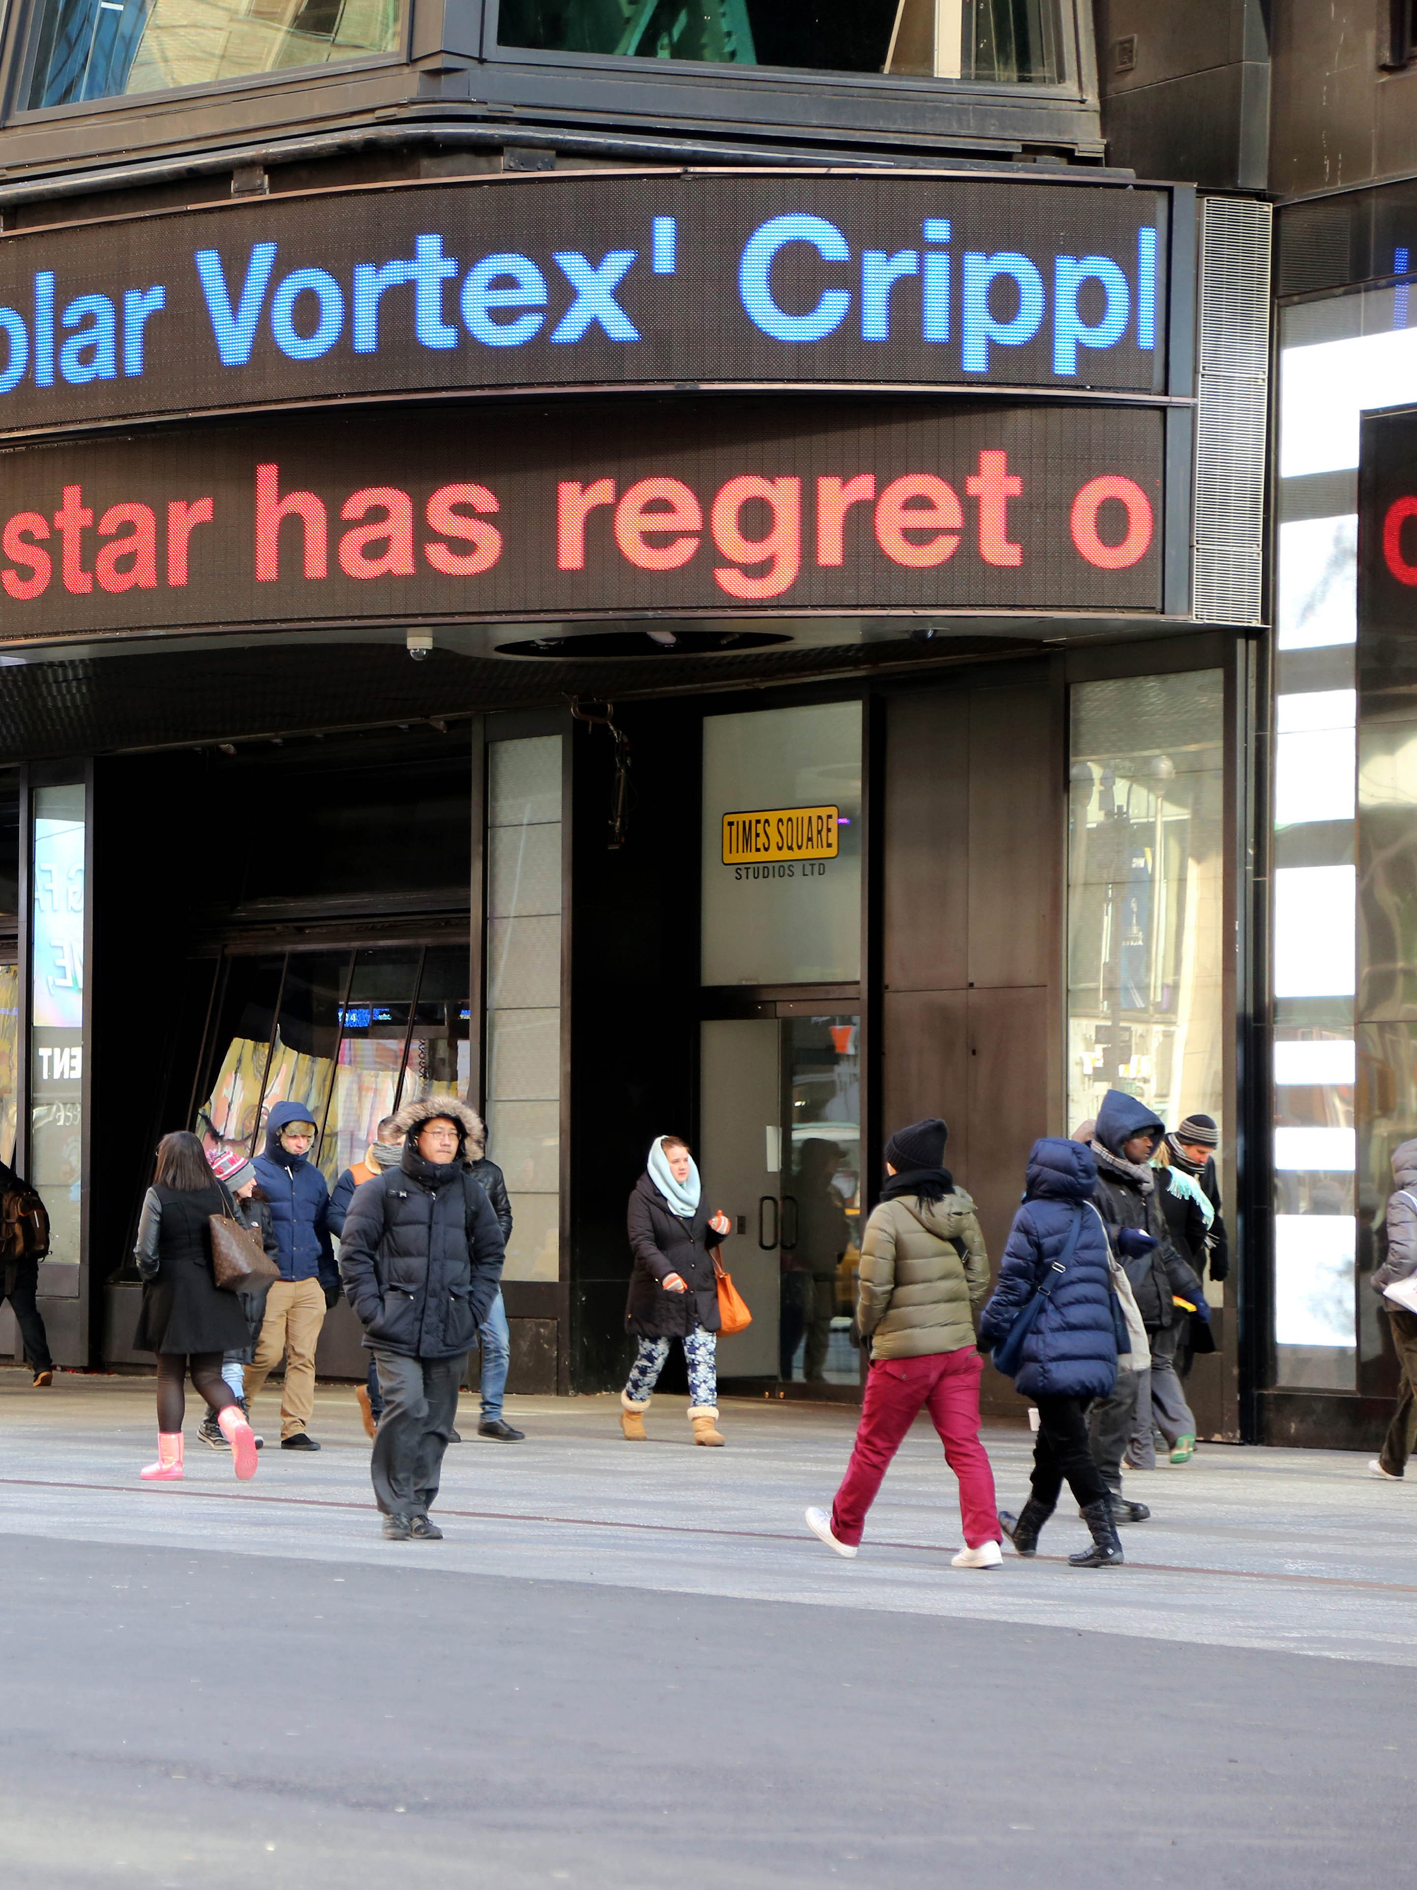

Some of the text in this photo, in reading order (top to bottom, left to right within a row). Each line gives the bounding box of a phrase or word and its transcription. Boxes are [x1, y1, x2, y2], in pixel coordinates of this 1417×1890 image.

[195, 216, 677, 366] Vortex'
[738, 212, 1158, 376] Crippl
[1, 484, 214, 600] star
[255, 463, 503, 582] has
[556, 449, 1023, 599] regret
[727, 813, 833, 855] TIMES SQUARE
[734, 862, 826, 881] STUDIOS LTD
